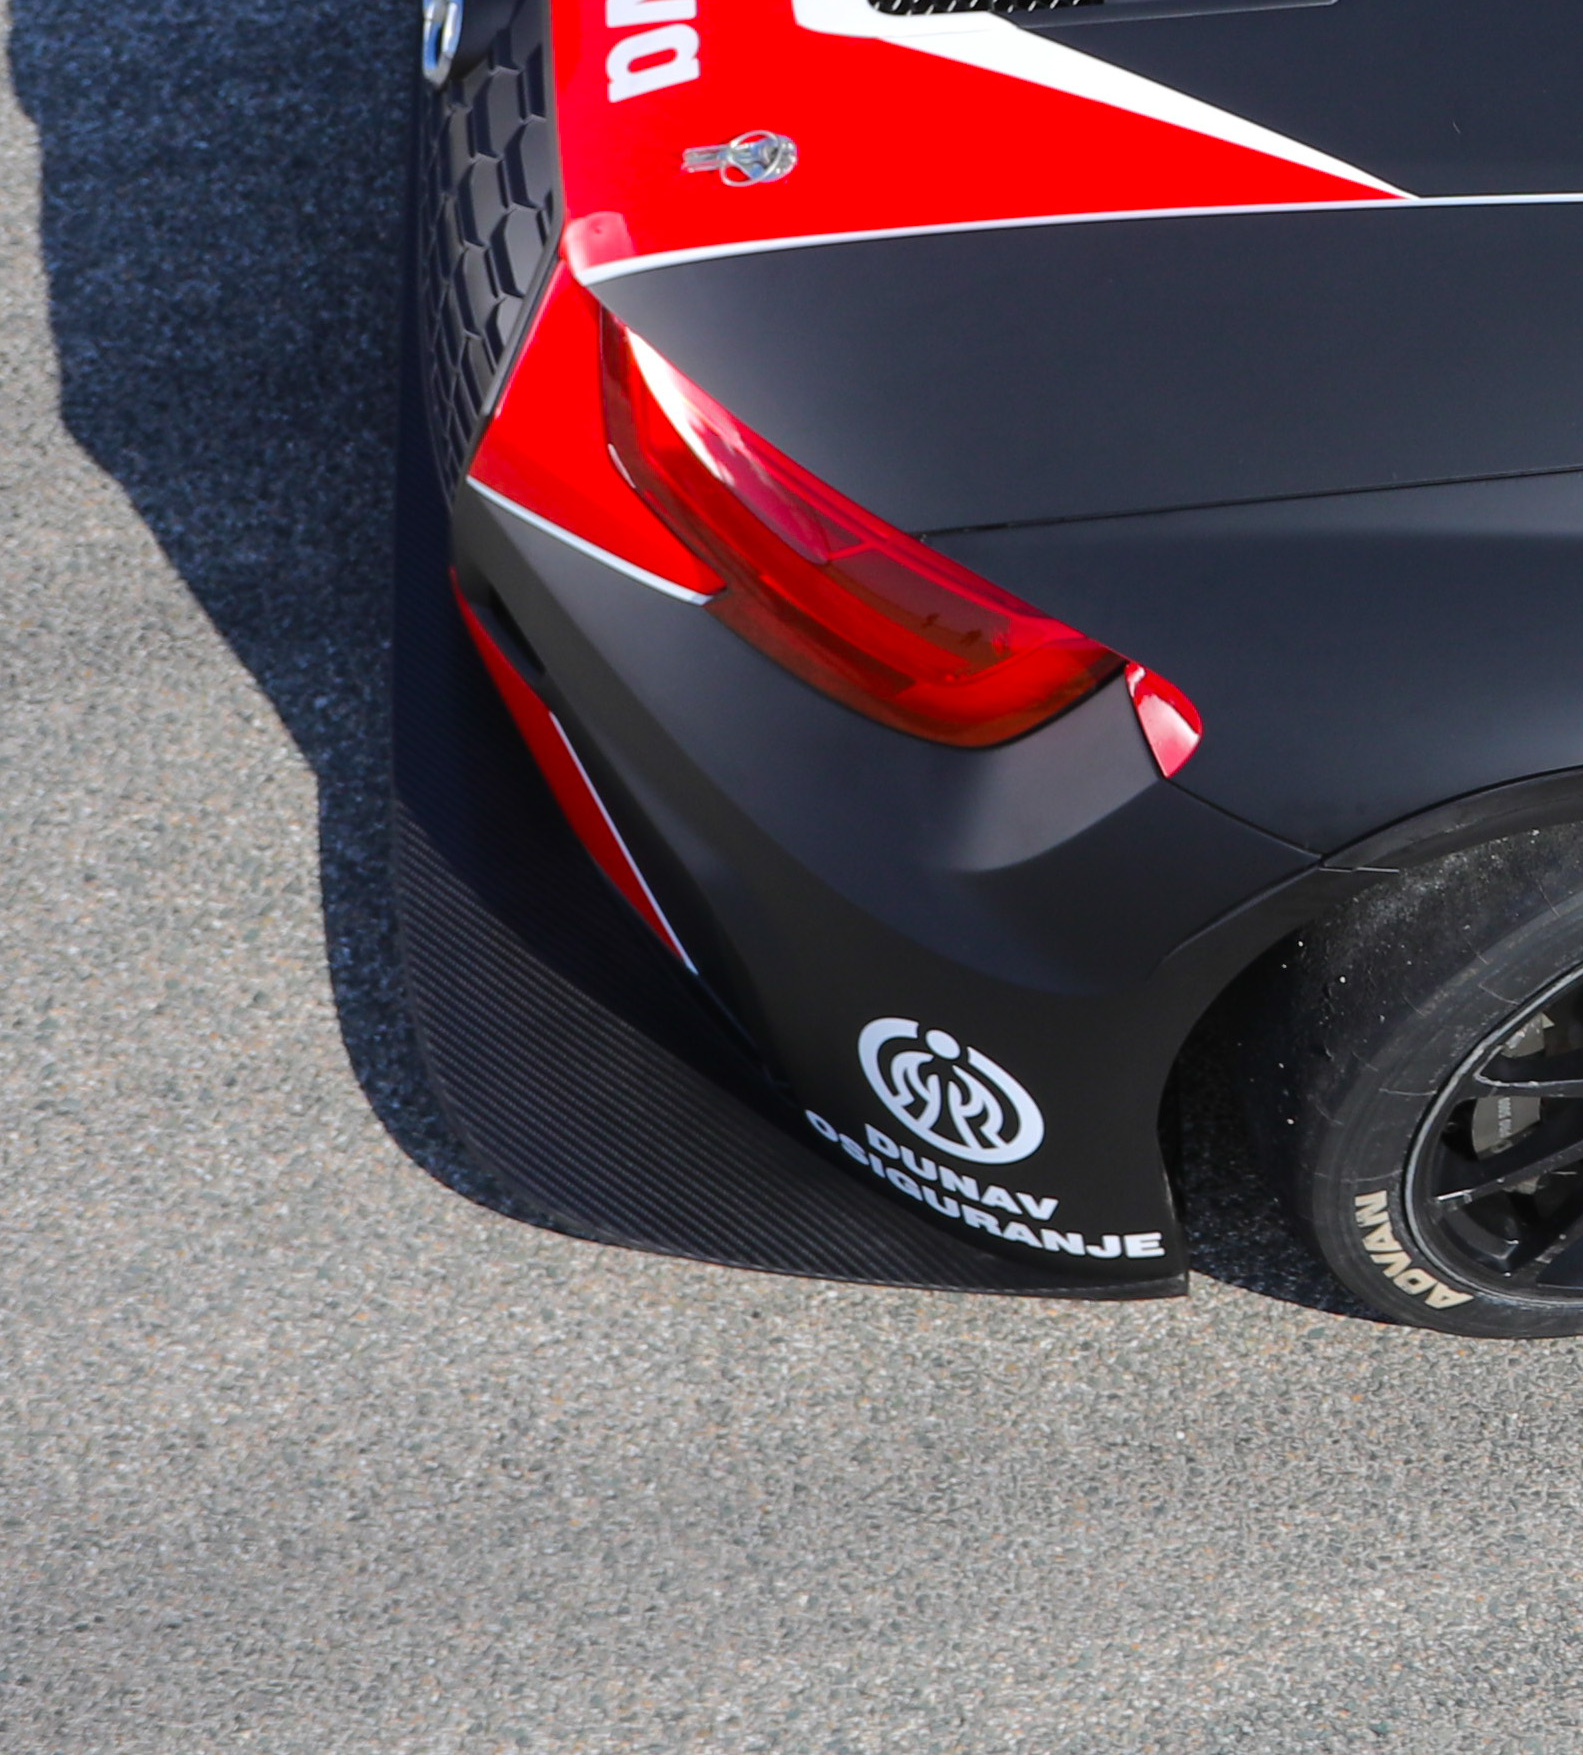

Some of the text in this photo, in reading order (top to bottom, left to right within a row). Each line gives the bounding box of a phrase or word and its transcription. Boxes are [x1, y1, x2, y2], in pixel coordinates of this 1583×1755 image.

[805, 1110, 1166, 1259] OSIGURANJE
[865, 1123, 1060, 1221] DUNAV
[1355, 1191, 1475, 1309] ADVAN
